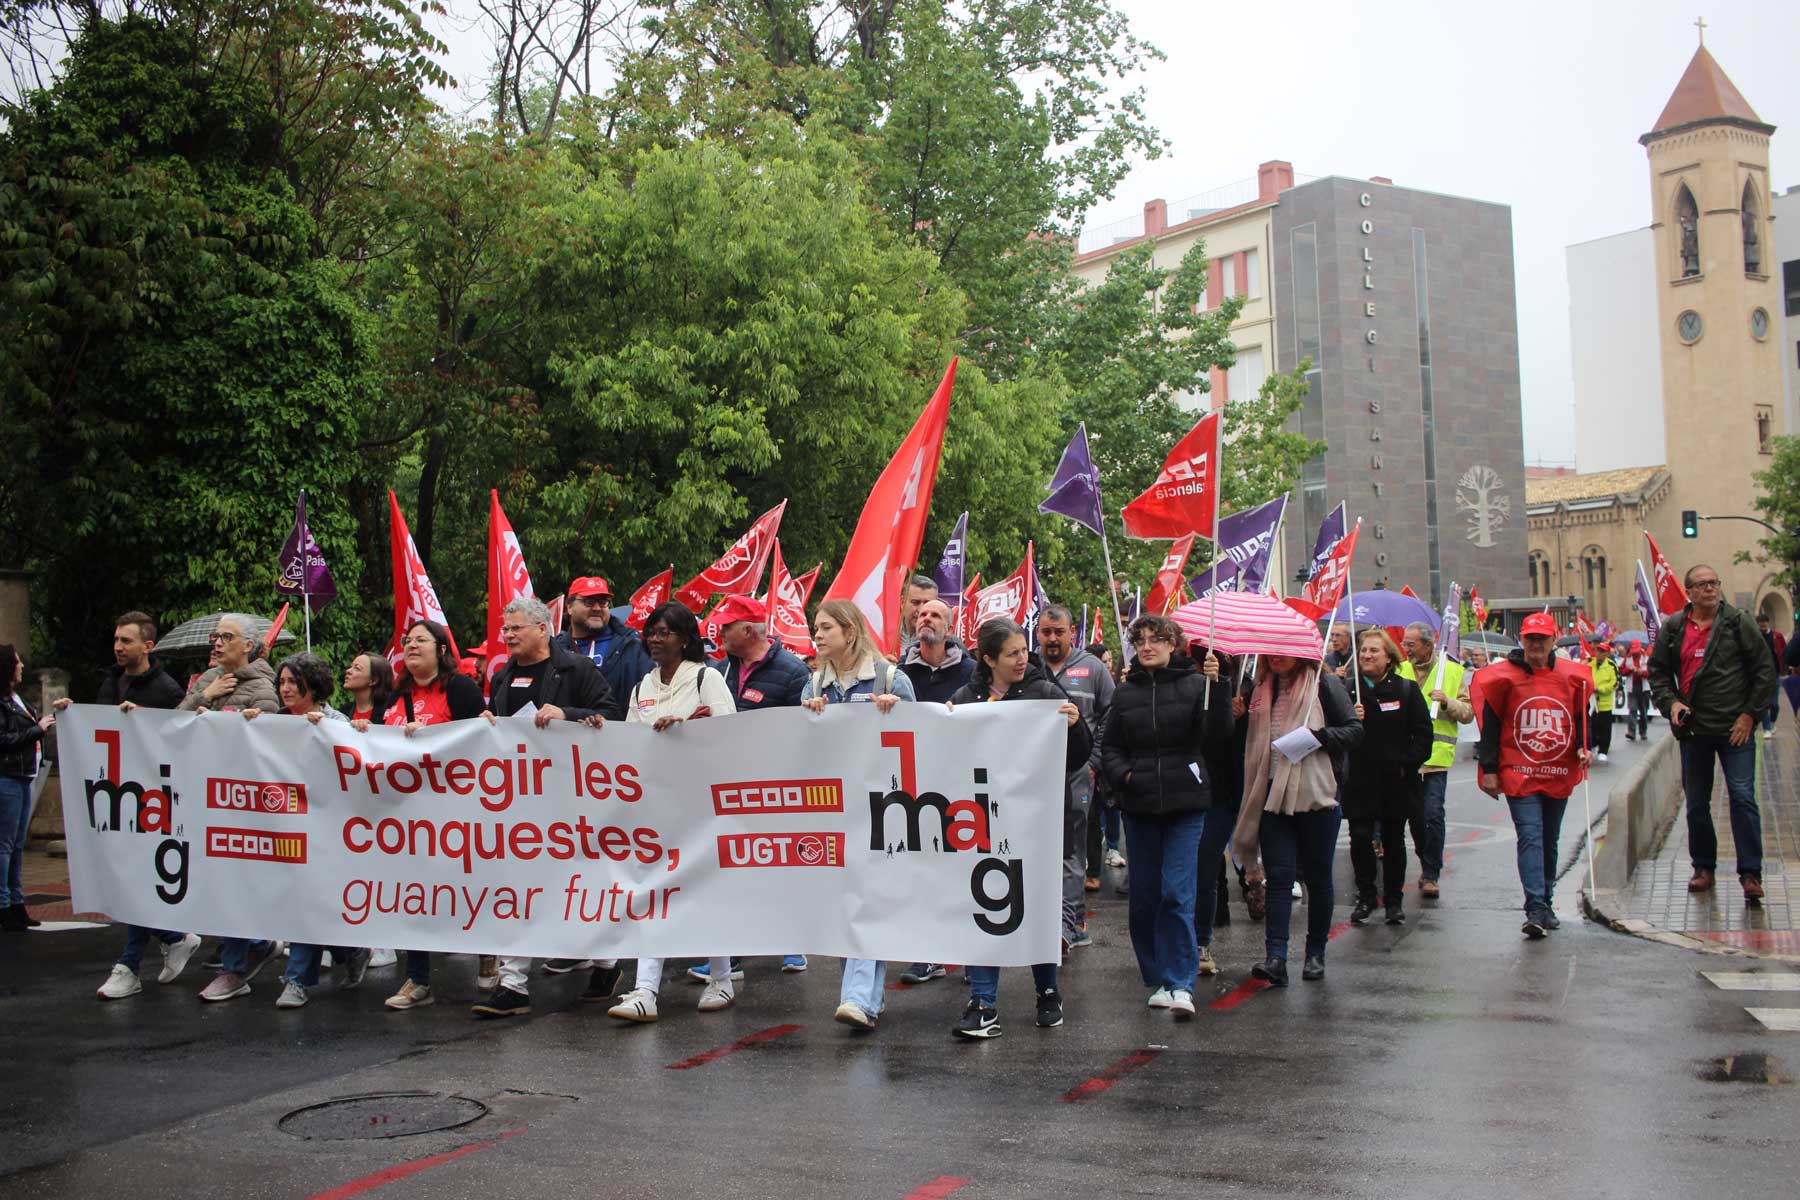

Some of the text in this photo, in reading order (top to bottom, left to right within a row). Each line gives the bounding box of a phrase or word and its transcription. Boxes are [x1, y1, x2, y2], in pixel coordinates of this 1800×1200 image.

[1370, 400, 1384, 497] SANT
[1520, 709, 1564, 735] UGT
[333, 743, 643, 812] Protegir les
[1541, 766, 1569, 776] mano
[215, 782, 260, 810] UGT
[719, 787, 803, 809] CCOO
[211, 832, 274, 856] CCOO
[342, 815, 680, 874] conquestes,
[729, 837, 792, 865] UGT
[341, 874, 681, 931] guanyar futur
